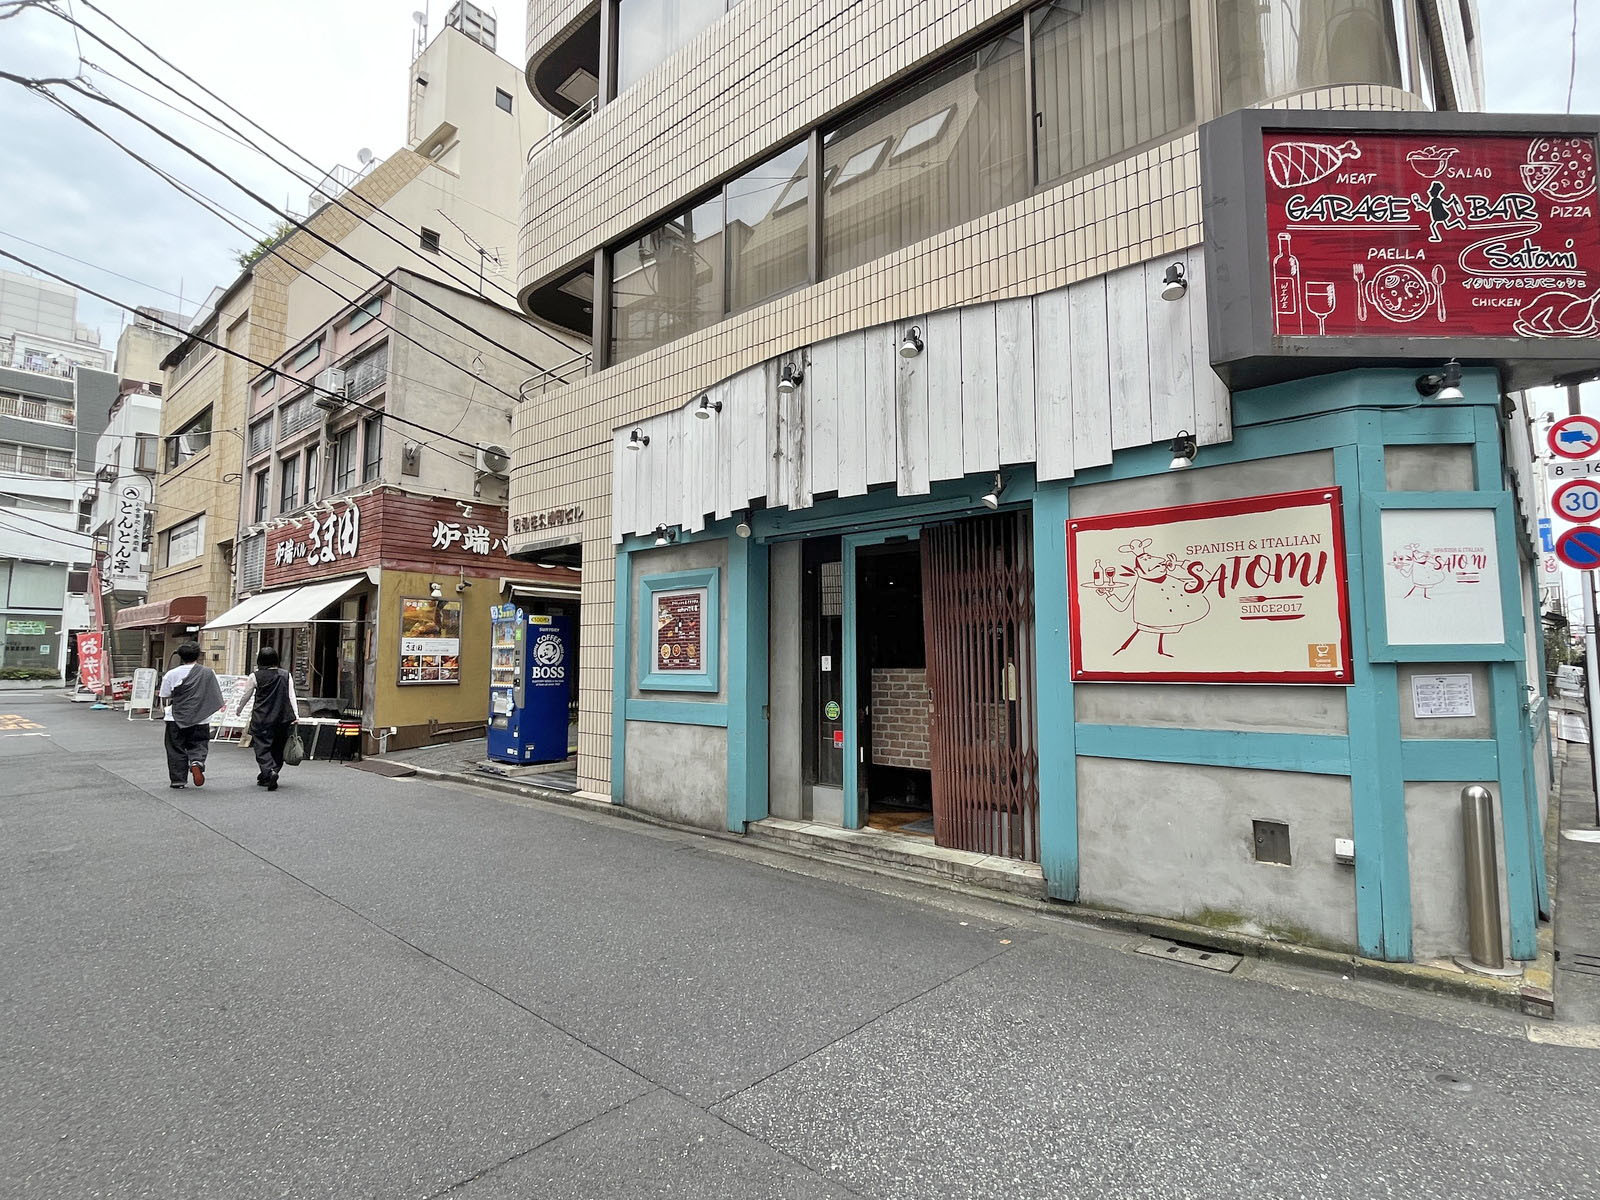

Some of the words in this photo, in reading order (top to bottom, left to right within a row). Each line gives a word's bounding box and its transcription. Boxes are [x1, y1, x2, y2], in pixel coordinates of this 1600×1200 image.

[1336, 173, 1377, 184] MEAT
[1446, 167, 1492, 179] SALAD
[1285, 195, 1411, 222] GARAGE
[1465, 194, 1539, 220] BAR
[1550, 206, 1592, 218] PIZZA
[1367, 248, 1426, 260] PAELLA
[1483, 239, 1578, 269] Satomi
[1280, 282, 1289, 309] WINE
[1471, 297, 1521, 307] CHICKEN
[1566, 491, 1598, 511] 30
[114, 500, 133, 573] とんとん亭
[1186, 542, 1245, 556] SPANISH
[1248, 540, 1258, 550] &
[1261, 533, 1321, 548] ITALIAN
[1183, 551, 1328, 599] SATOMI
[1241, 603, 1302, 614] SINCE2017
[537, 634, 562, 645] COFFEE
[532, 666, 565, 679] BOSS
